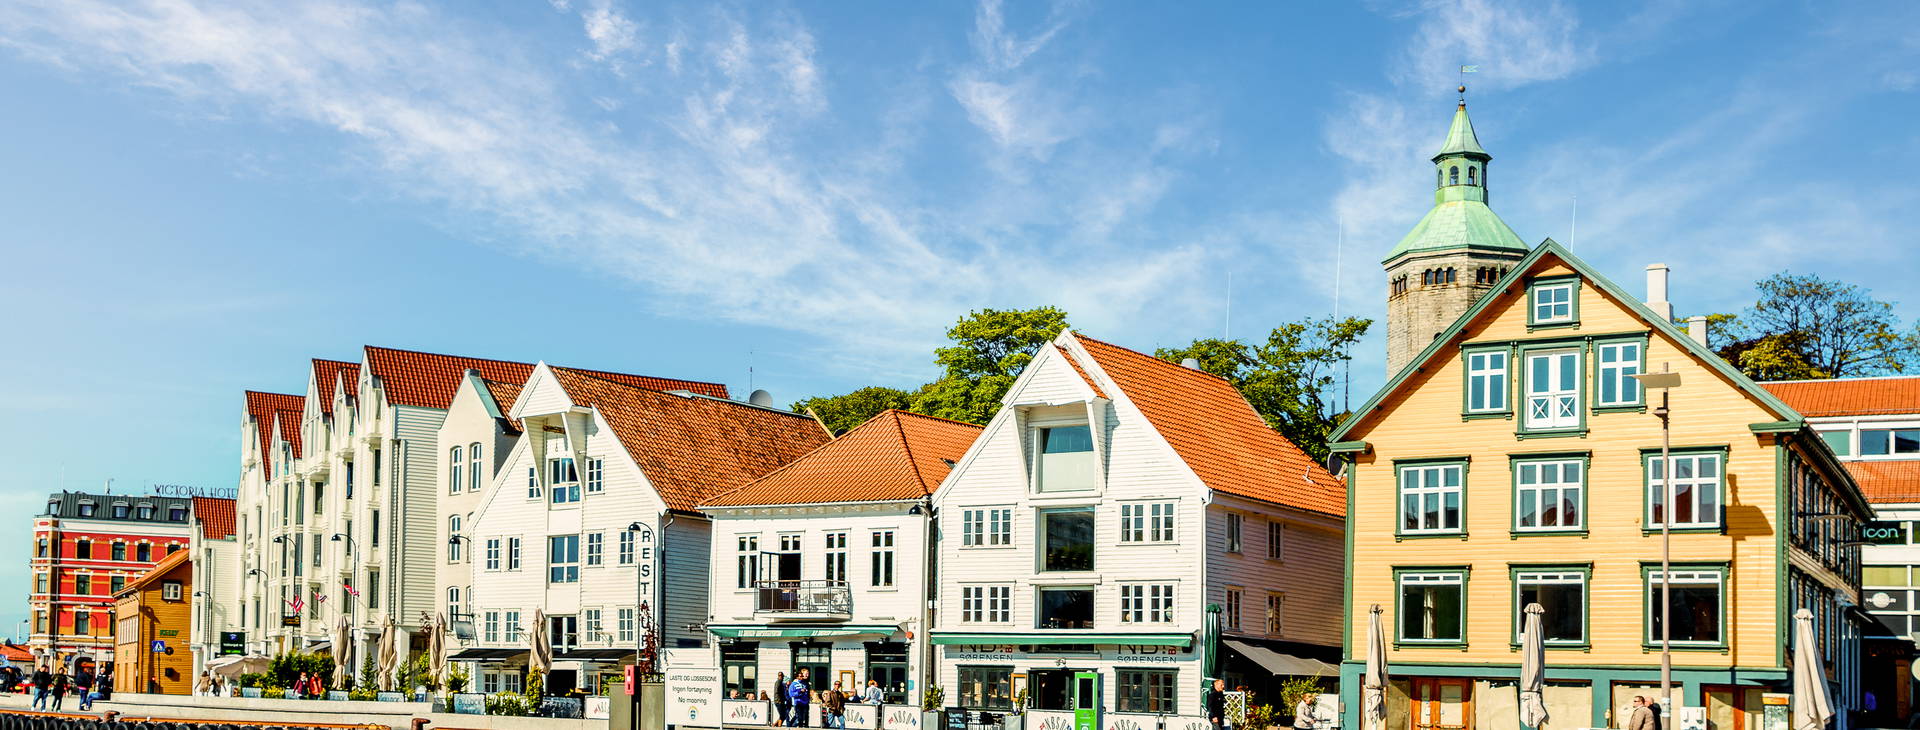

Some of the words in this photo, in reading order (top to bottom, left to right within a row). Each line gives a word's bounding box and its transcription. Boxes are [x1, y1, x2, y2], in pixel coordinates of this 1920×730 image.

[154, 484, 205, 497] VICTORIA
[210, 487, 238, 498] HOTE
[1863, 526, 1899, 538] icon
[960, 653, 1013, 661] SØRENSEN
[1117, 655, 1177, 663] SØRENSEN
